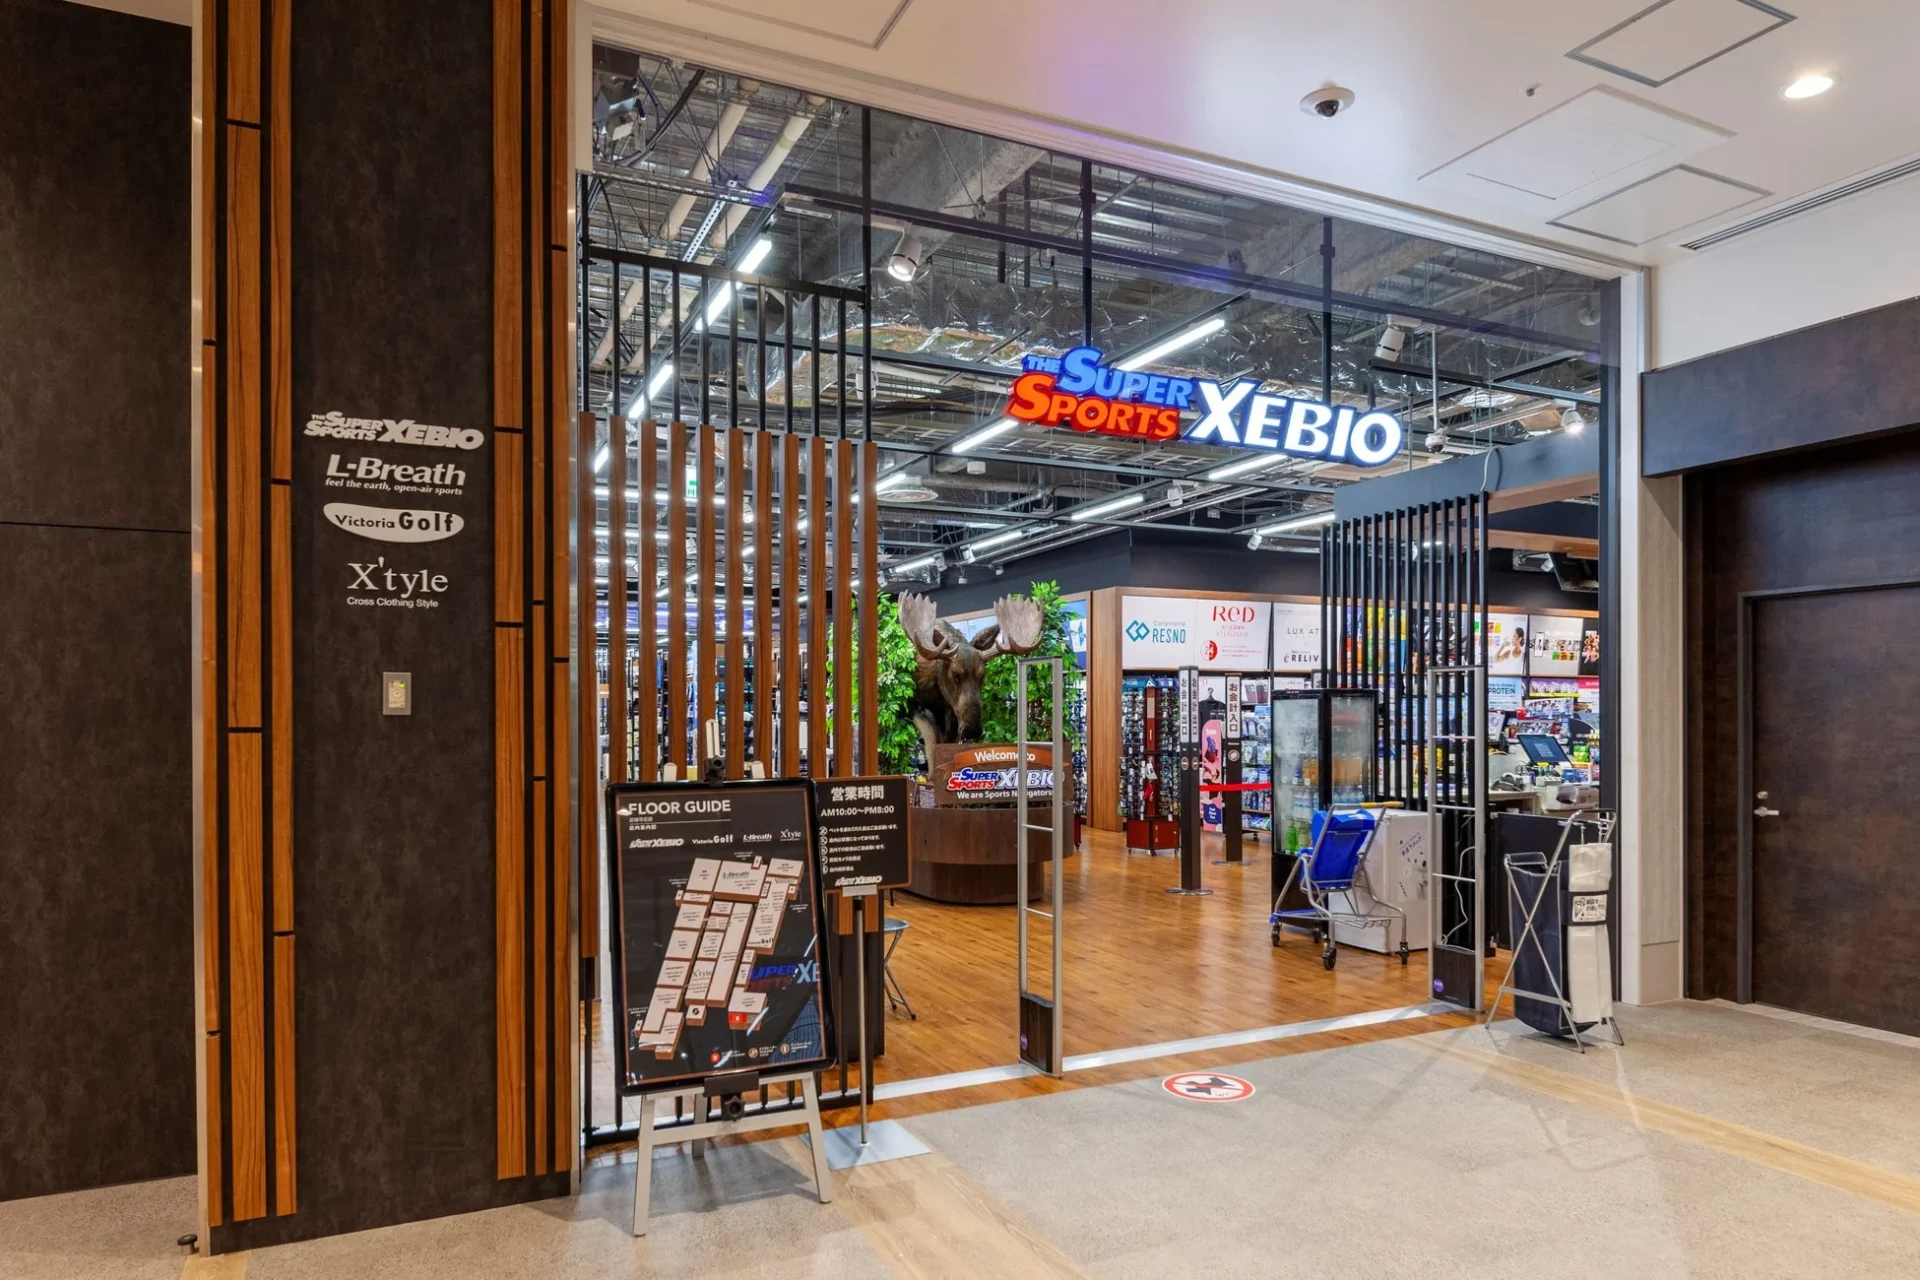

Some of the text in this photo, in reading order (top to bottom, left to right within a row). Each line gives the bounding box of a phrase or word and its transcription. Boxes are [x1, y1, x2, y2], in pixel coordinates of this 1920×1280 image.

[1025, 353, 1061, 374] THE
[1058, 346, 1195, 409] SUPER
[1010, 373, 1181, 440] SPORTS
[304, 420, 378, 441] SPORTS
[325, 411, 385, 432] SUPER
[1186, 380, 1402, 465] XEBIO
[377, 419, 485, 450] XEBIO
[326, 454, 467, 487] L-Breath
[325, 478, 463, 496] feel the earth, open-air sports
[335, 511, 454, 532] Victoria Golf
[346, 556, 449, 599] X'tyle
[346, 596, 439, 609] Cross Clothing Style
[1152, 629, 1187, 644] RESNO
[1228, 683, 1239, 733] お会計入口
[947, 776, 995, 790] SPORTS
[959, 767, 1000, 780] SUPER
[831, 785, 884, 802] 営業時間
[957, 791, 970, 799] We
[985, 790, 1010, 799] Sports
[628, 799, 732, 816] FLOOR GUIDE
[713, 834, 734, 844] Golf
[743, 833, 773, 841] L-Breath
